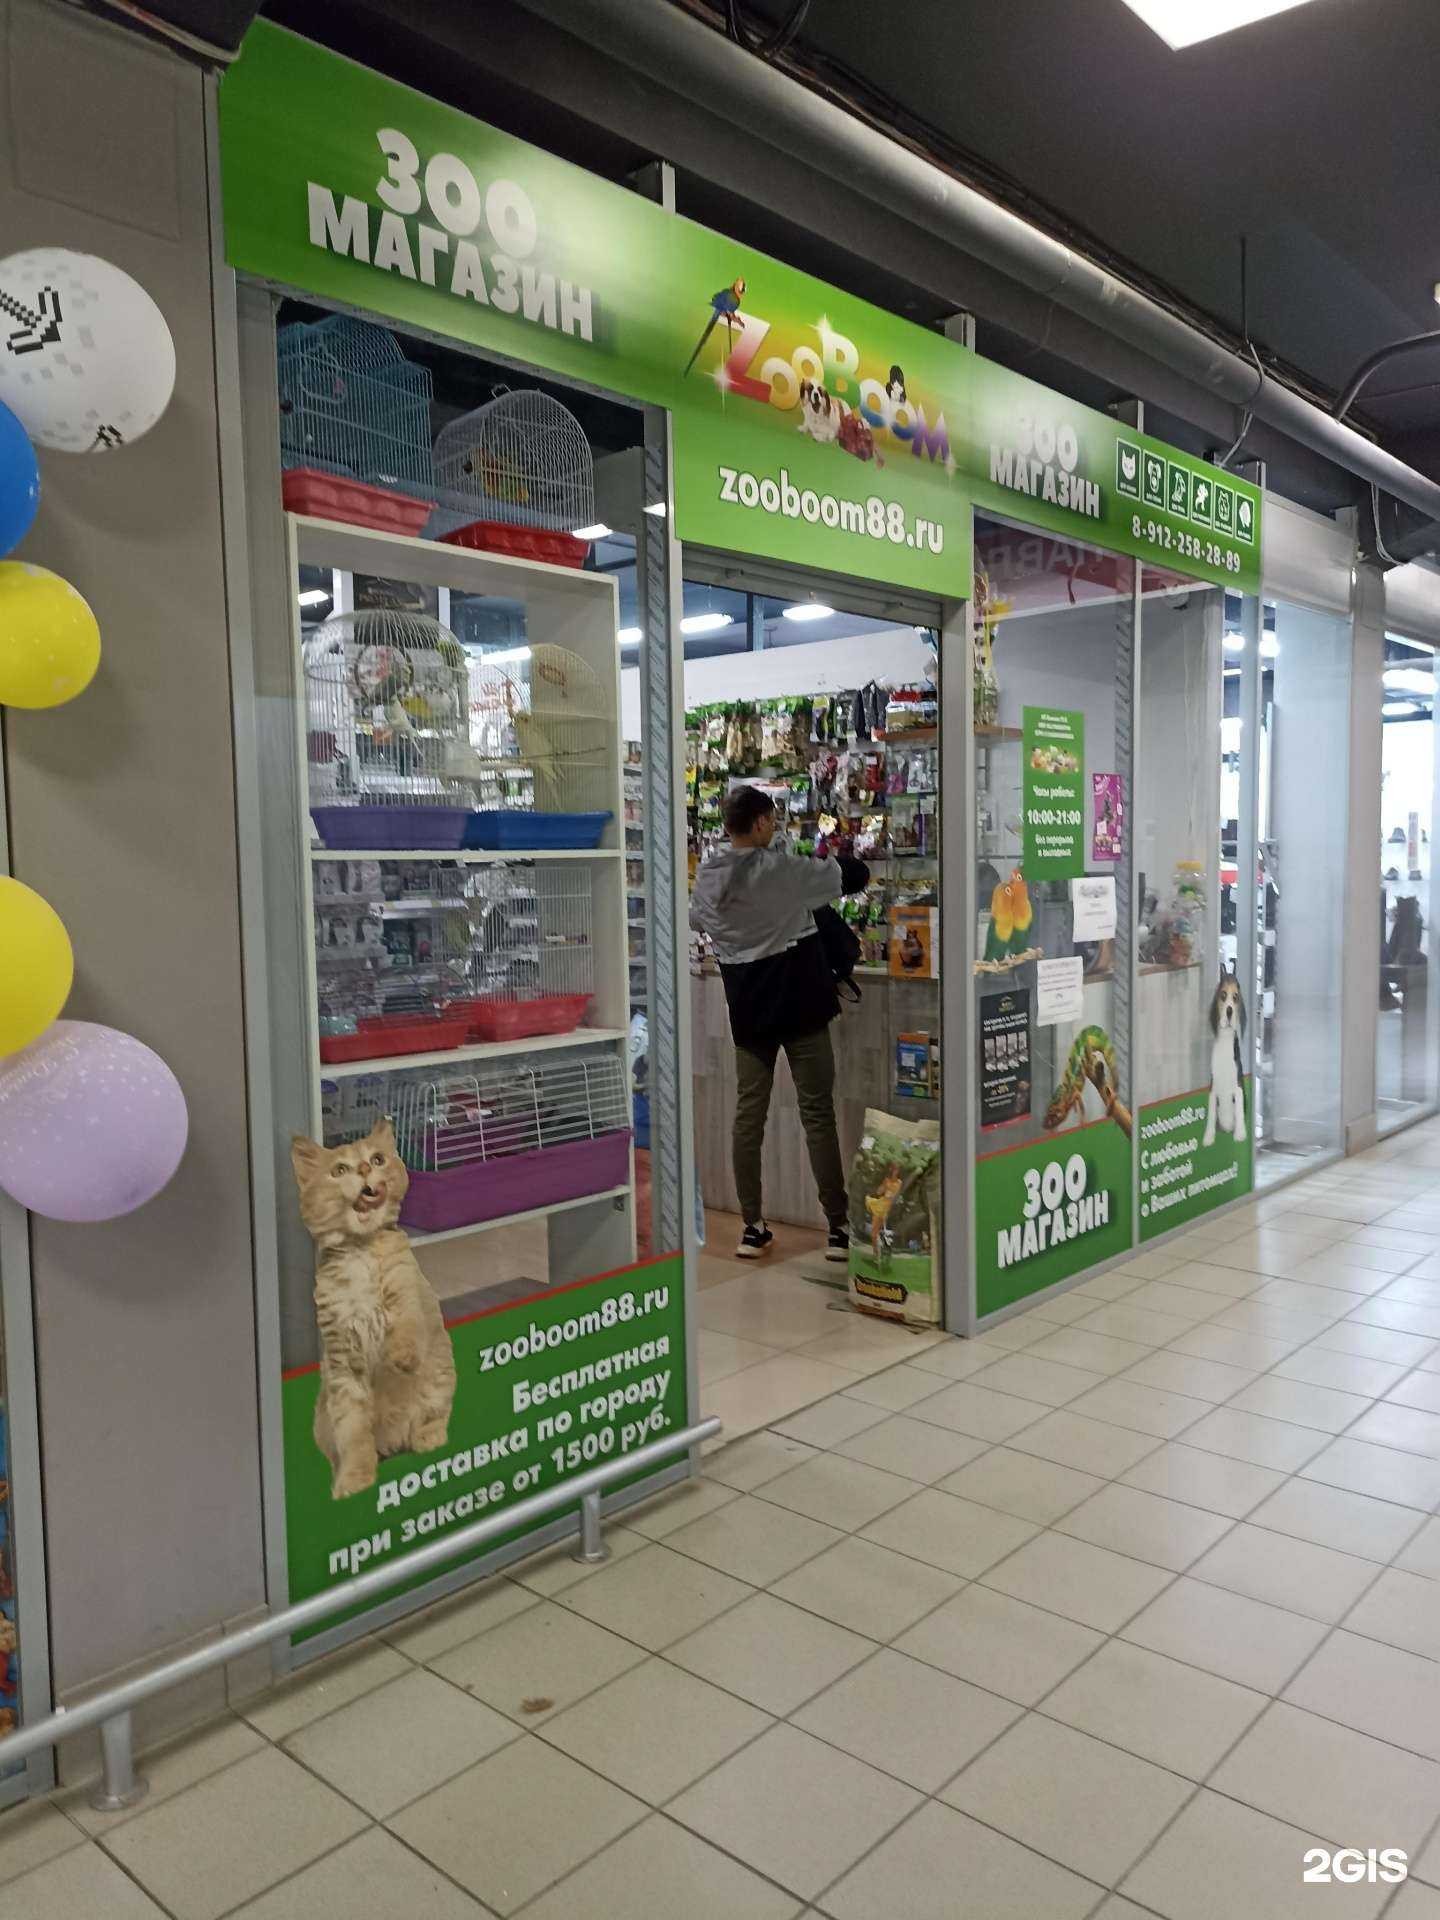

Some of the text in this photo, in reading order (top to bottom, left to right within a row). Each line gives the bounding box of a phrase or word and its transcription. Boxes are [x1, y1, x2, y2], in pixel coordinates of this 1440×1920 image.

[376, 128, 537, 259] ЗОО
[307, 181, 593, 342] МАГАЗИН
[719, 466, 944, 554] zooboom88.ru
[990, 443, 1100, 519] МАГАЗИН
[1132, 515, 1241, 573] 8-912-258-28-89
[1027, 809, 1081, 825] 10:00-21:00
[1023, 1154, 1087, 1218] ЗОО
[1141, 1150, 1149, 1170] С
[1141, 1179, 1149, 1194] и
[997, 1189, 1109, 1269] МАГАЗИН
[478, 1286, 670, 1373] zooboom88.ru
[512, 1336, 670, 1413] Бесплатная
[377, 1369, 671, 1513] доставка по городу
[329, 1404, 672, 1574] при заказе от 1500 руб.
